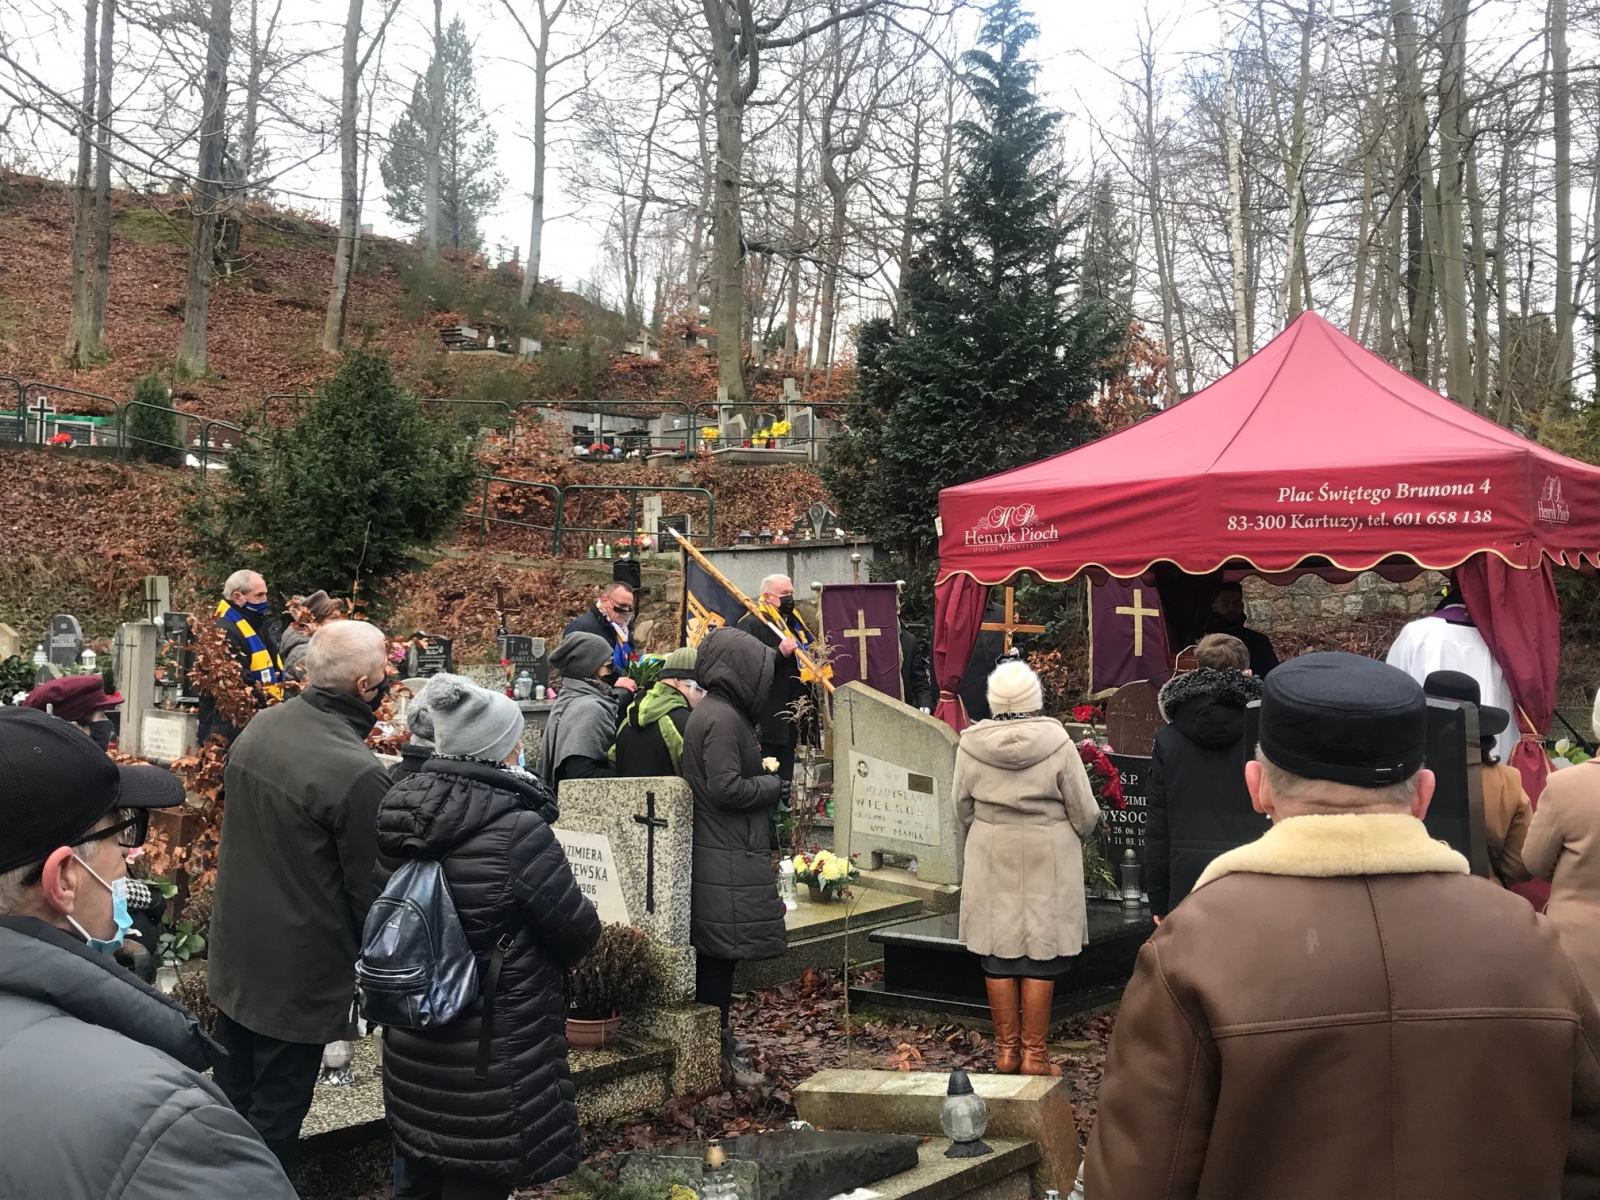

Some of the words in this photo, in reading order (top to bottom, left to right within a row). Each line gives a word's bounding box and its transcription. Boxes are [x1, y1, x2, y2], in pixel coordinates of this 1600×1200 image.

[1276, 486, 1315, 503] Plac
[1317, 481, 1392, 506] Świętego
[1394, 482, 1475, 499] Brunona
[1478, 478, 1492, 495] 4
[1227, 514, 1287, 531] 83-300
[1289, 513, 1363, 533] Kartuzy,
[1367, 512, 1390, 527] tel.
[1392, 511, 1422, 526] 601
[1426, 511, 1458, 525] 658
[1461, 509, 1493, 524] 138
[964, 527, 1016, 547] Henryk
[1019, 524, 1059, 541] Pioch
